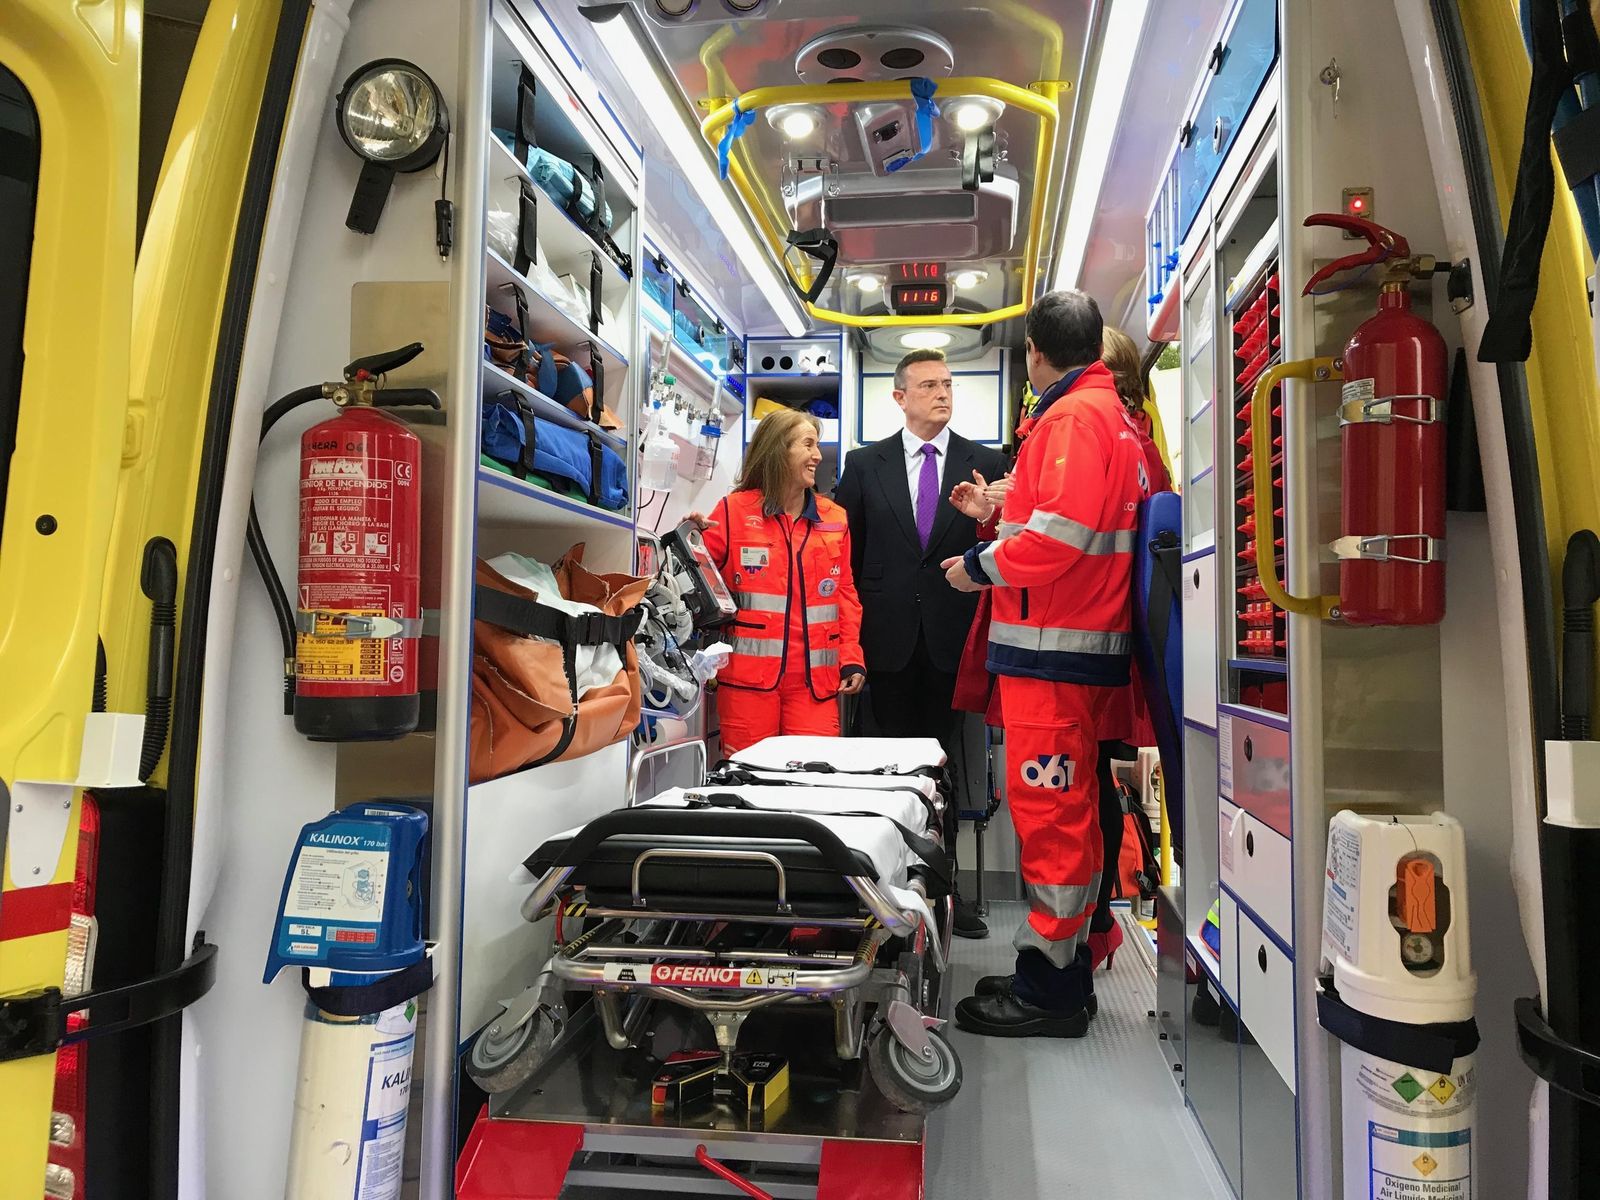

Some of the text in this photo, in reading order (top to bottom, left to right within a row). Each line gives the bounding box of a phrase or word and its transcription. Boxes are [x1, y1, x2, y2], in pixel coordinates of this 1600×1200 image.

[903, 291, 939, 302] 1116
[338, 480, 388, 489] INCENDIOS
[379, 535, 387, 543] C
[1020, 755, 1077, 789] 061
[309, 832, 361, 846] KALINOX
[671, 966, 734, 983] FERNO
[1380, 1187, 1393, 1198] Air
[1422, 1182, 1461, 1193] Medicinal
